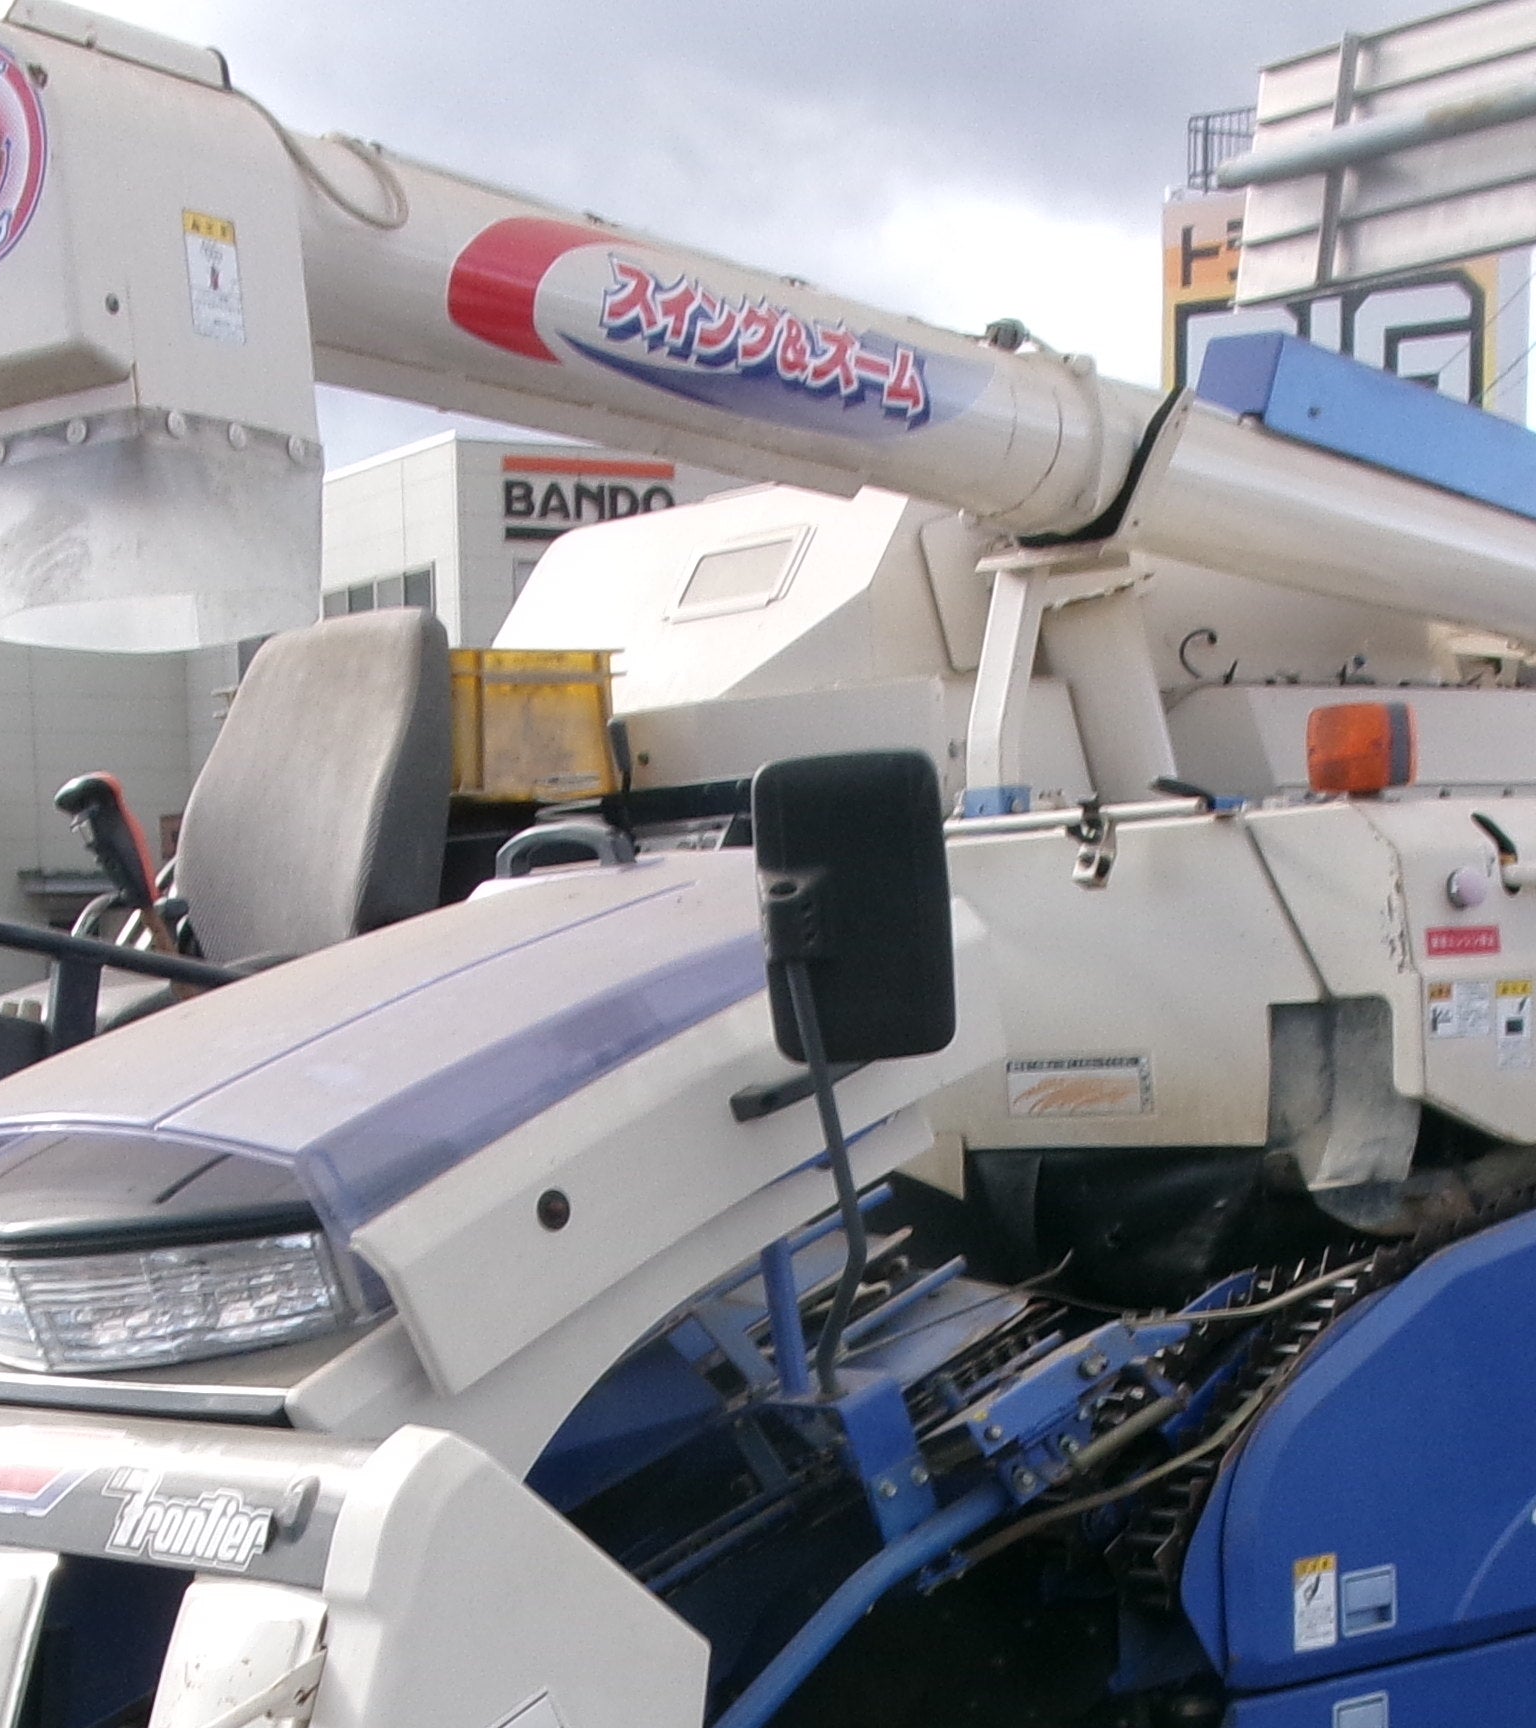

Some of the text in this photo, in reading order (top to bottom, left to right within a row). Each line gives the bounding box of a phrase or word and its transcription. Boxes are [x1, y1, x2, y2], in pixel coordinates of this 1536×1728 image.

[601, 255, 929, 426] スイング&ズーム
[503, 480, 675, 521] BANDO
[101, 1466, 274, 1572] Frontier
